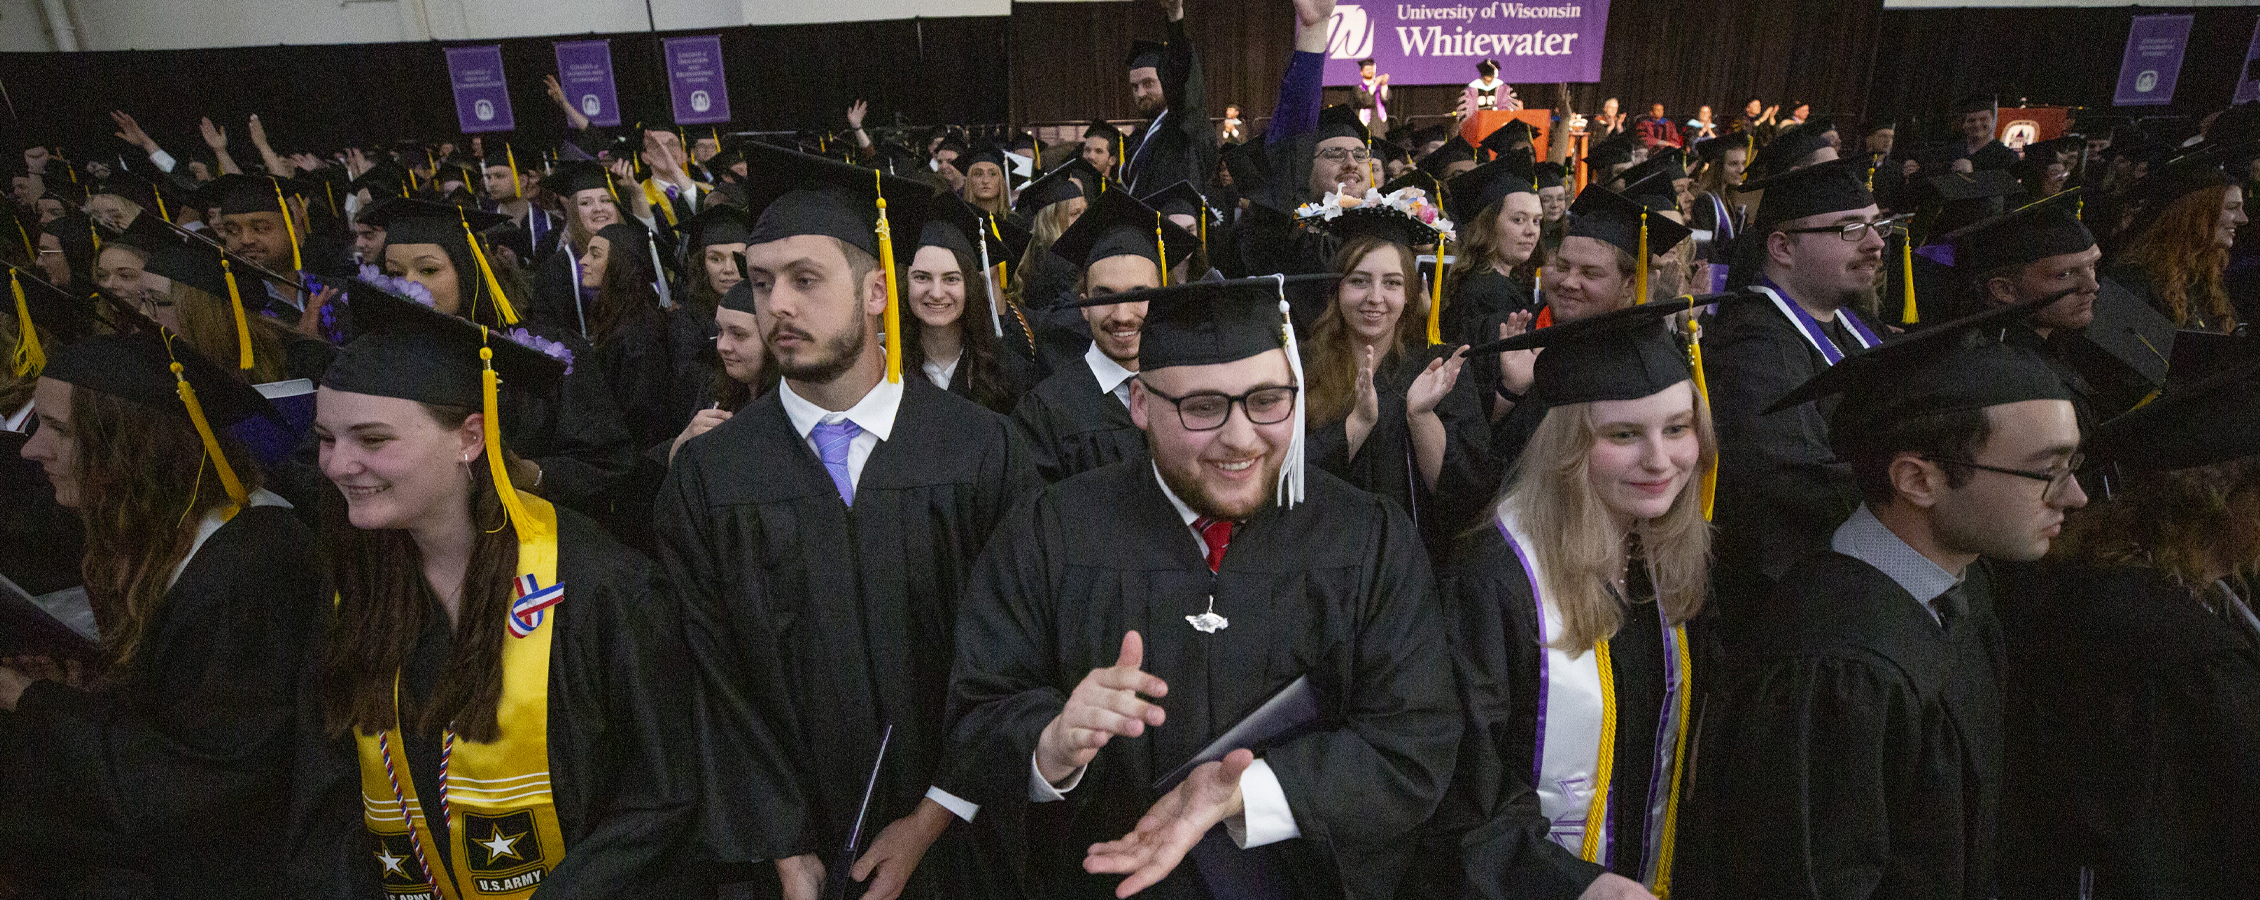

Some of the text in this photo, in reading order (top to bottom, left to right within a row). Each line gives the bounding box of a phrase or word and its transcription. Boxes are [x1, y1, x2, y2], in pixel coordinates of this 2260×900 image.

[1397, 2, 1581, 23] University of Wisconsin
[1395, 26, 1578, 56] Whitewater
